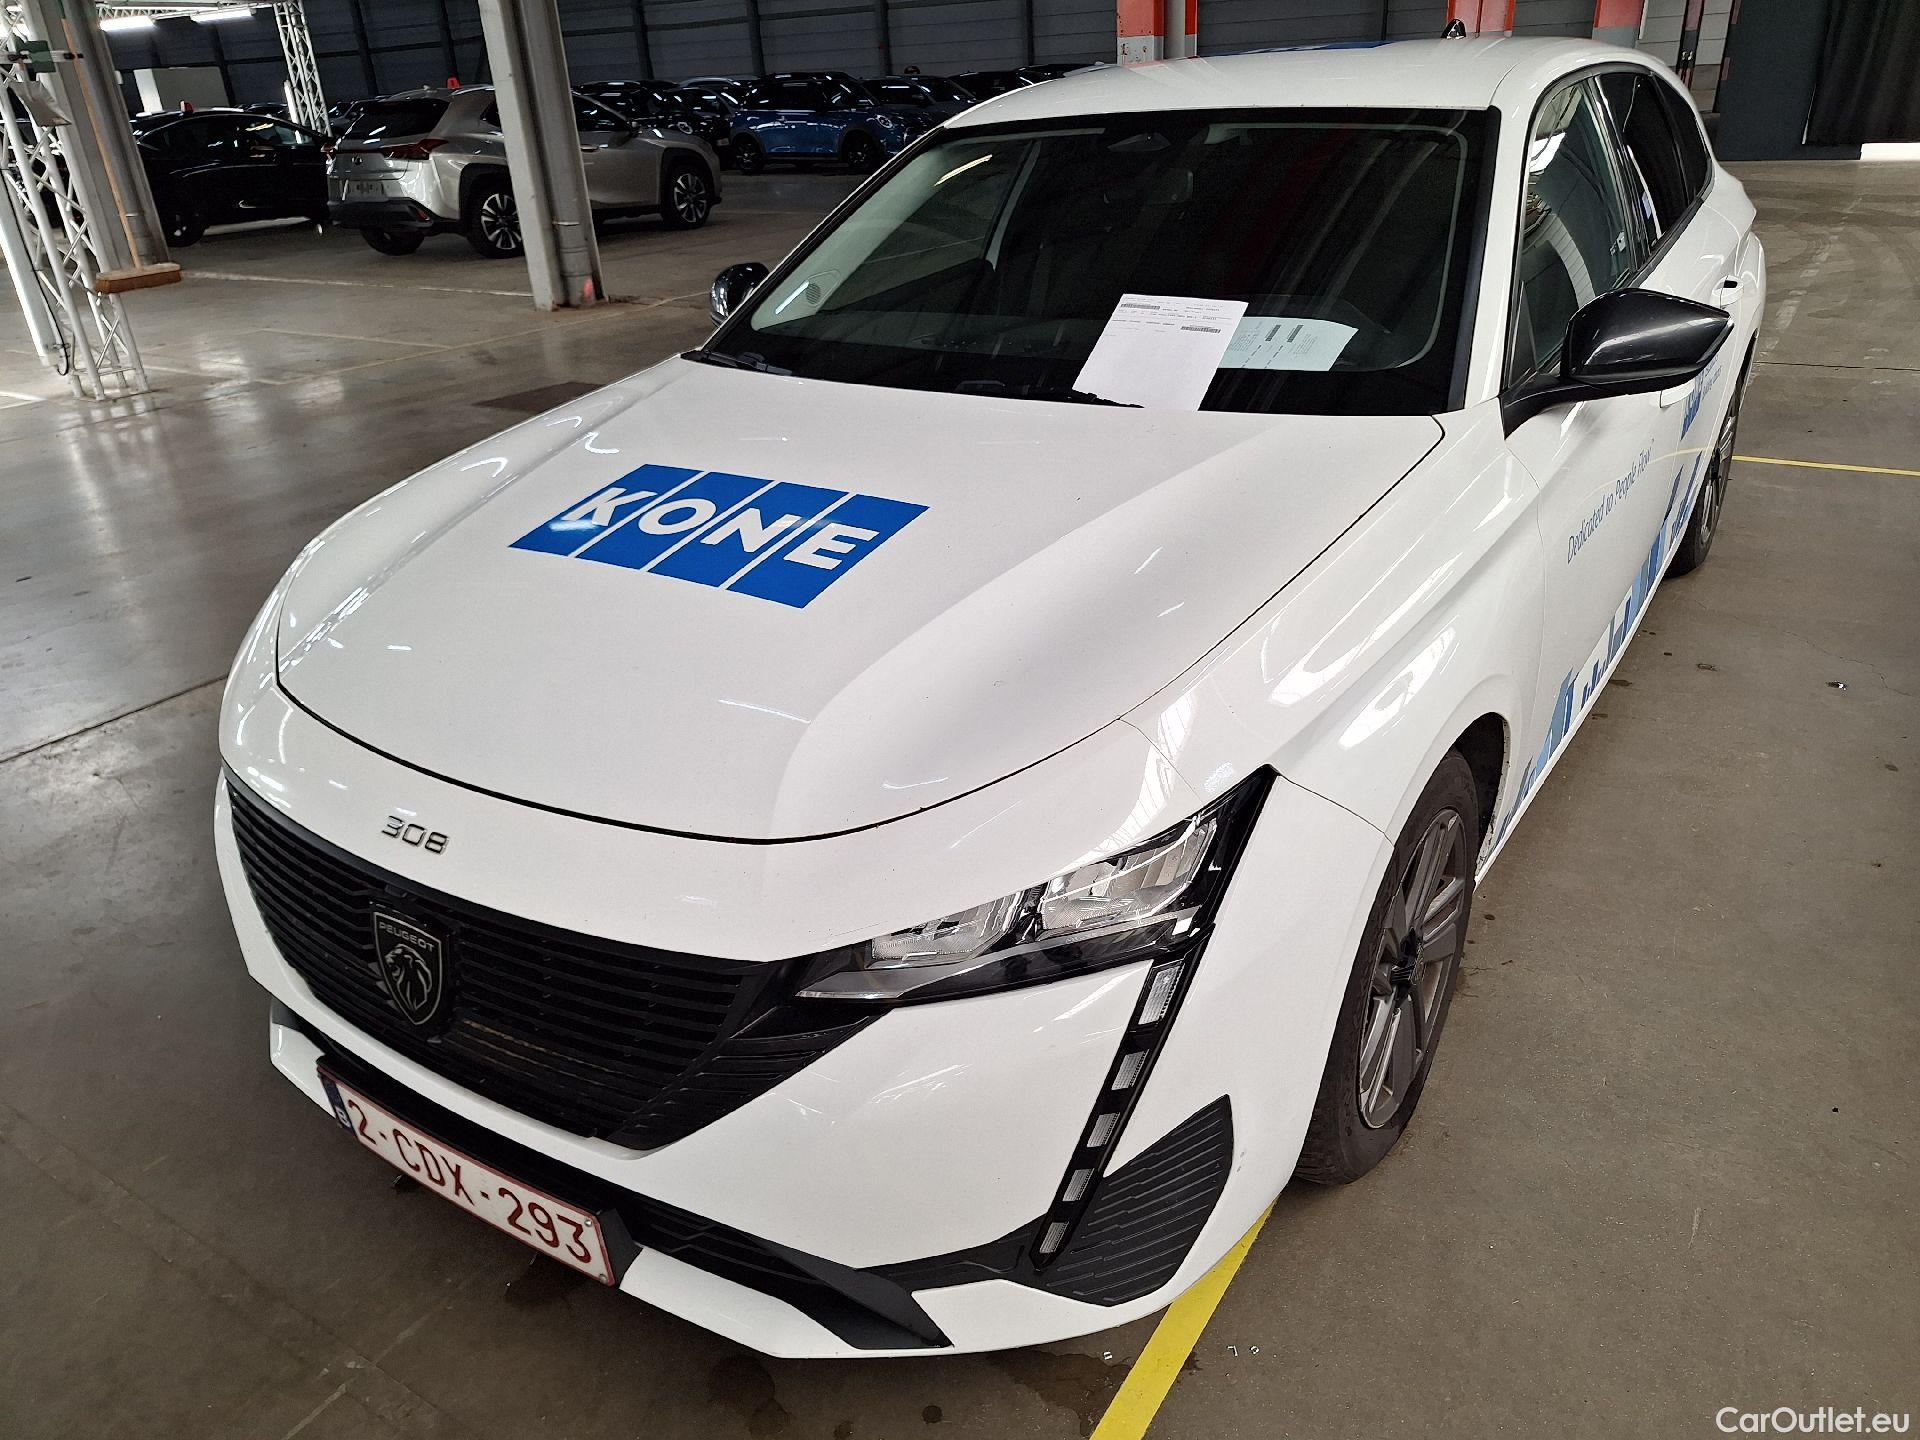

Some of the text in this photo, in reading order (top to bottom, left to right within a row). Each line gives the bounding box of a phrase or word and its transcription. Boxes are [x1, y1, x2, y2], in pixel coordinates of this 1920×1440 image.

[560, 486, 881, 571] KONE
[1567, 493, 1606, 564] Dedicated
[1605, 492, 1614, 516] to
[381, 814, 450, 855] 308
[378, 921, 435, 953] PEUGEOT
[334, 1098, 592, 1264] B 2-CDX-293
